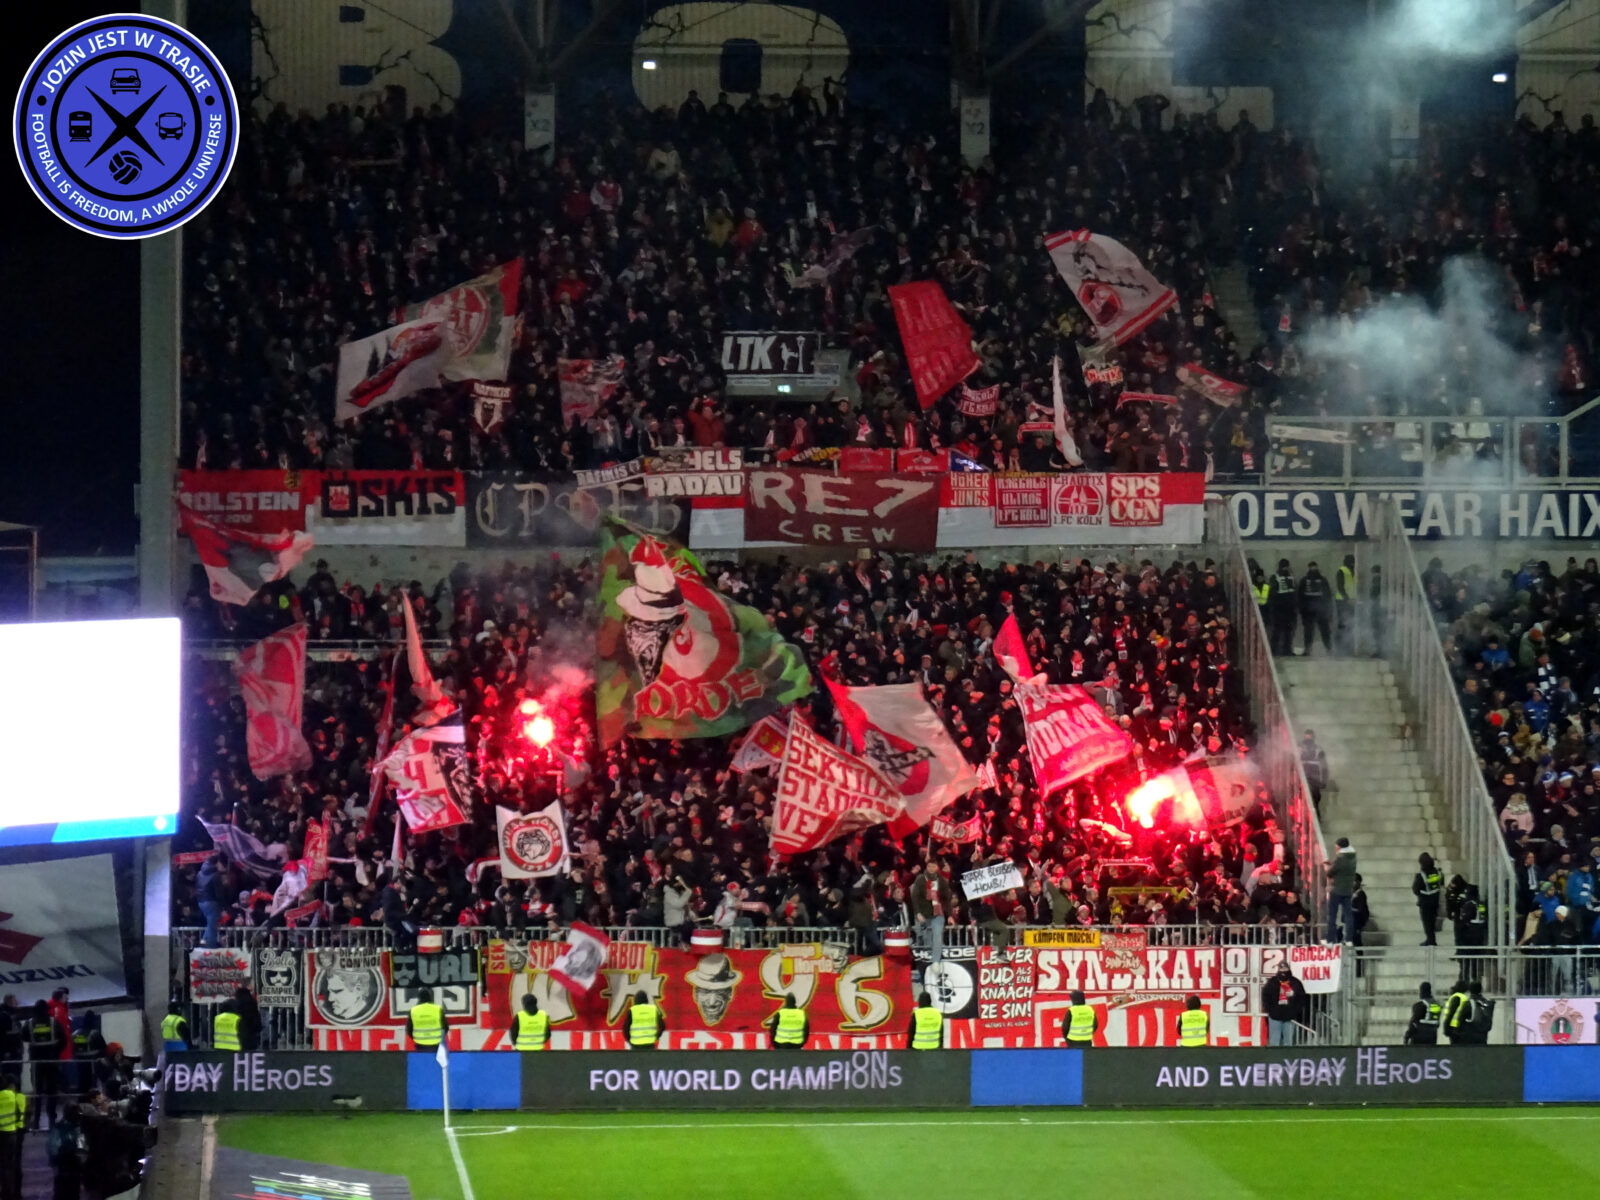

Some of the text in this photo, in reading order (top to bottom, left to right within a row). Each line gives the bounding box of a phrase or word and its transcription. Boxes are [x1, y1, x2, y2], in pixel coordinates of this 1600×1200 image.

[721, 336, 777, 370] LTK
[648, 474, 742, 496] RADAU
[1110, 475, 1160, 497] SPS
[1076, 515, 1103, 525] KÖLN
[1110, 499, 1162, 520] CGN
[779, 520, 895, 543] CREW
[492, 943, 506, 971] SEK
[980, 967, 1032, 985] DUD ALS
[1016, 976, 1032, 984] ENE
[1302, 966, 1331, 980] KÖLN
[980, 984, 1033, 1000] KNÄÄCH
[980, 1001, 1032, 1019] ZE SIN!
[233, 1053, 332, 1092] HEROES
[590, 1051, 903, 1091] FOR WORLD CHAMPIONS
[1156, 1047, 1452, 1087] AND EVERYDAY HEROES
